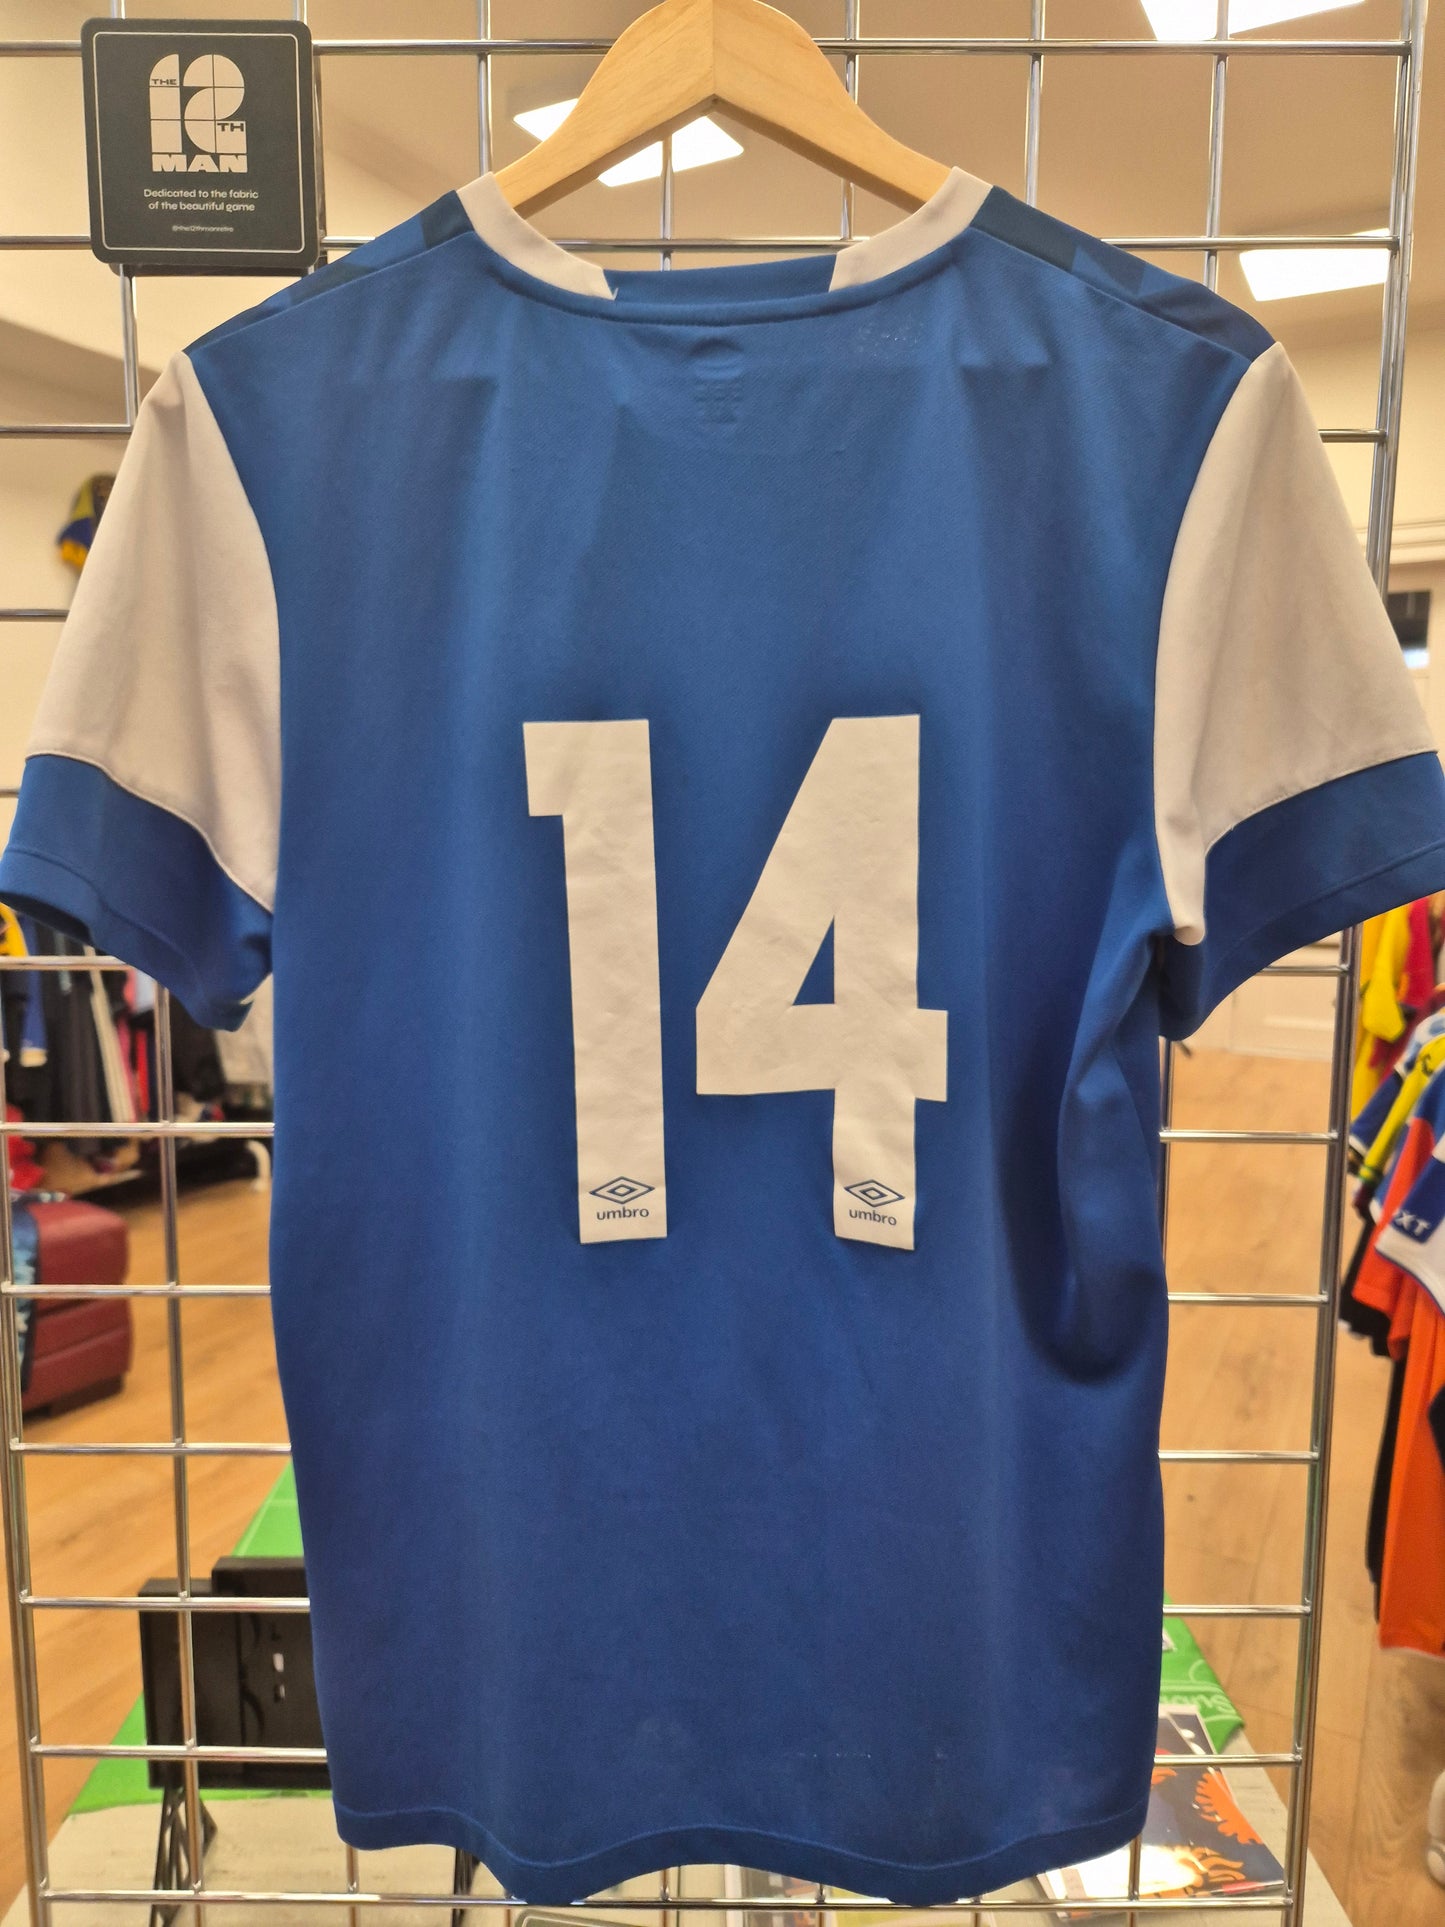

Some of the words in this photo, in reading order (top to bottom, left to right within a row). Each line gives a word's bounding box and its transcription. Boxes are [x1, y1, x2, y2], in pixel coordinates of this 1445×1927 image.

[151, 78, 177, 86] THE
[217, 122, 244, 132] TH
[152, 154, 248, 173] MAN
[143, 188, 197, 198] Dedicated
[198, 189, 209, 199] to
[210, 189, 228, 198] the
[229, 189, 259, 199] fabric
[148, 201, 159, 210] of
[161, 201, 178, 210] the
[179, 201, 225, 211] beautiful
[225, 203, 256, 213] game
[523, 714, 948, 1250] 14
[596, 1206, 650, 1221] umbro
[849, 1208, 898, 1227] umbro
